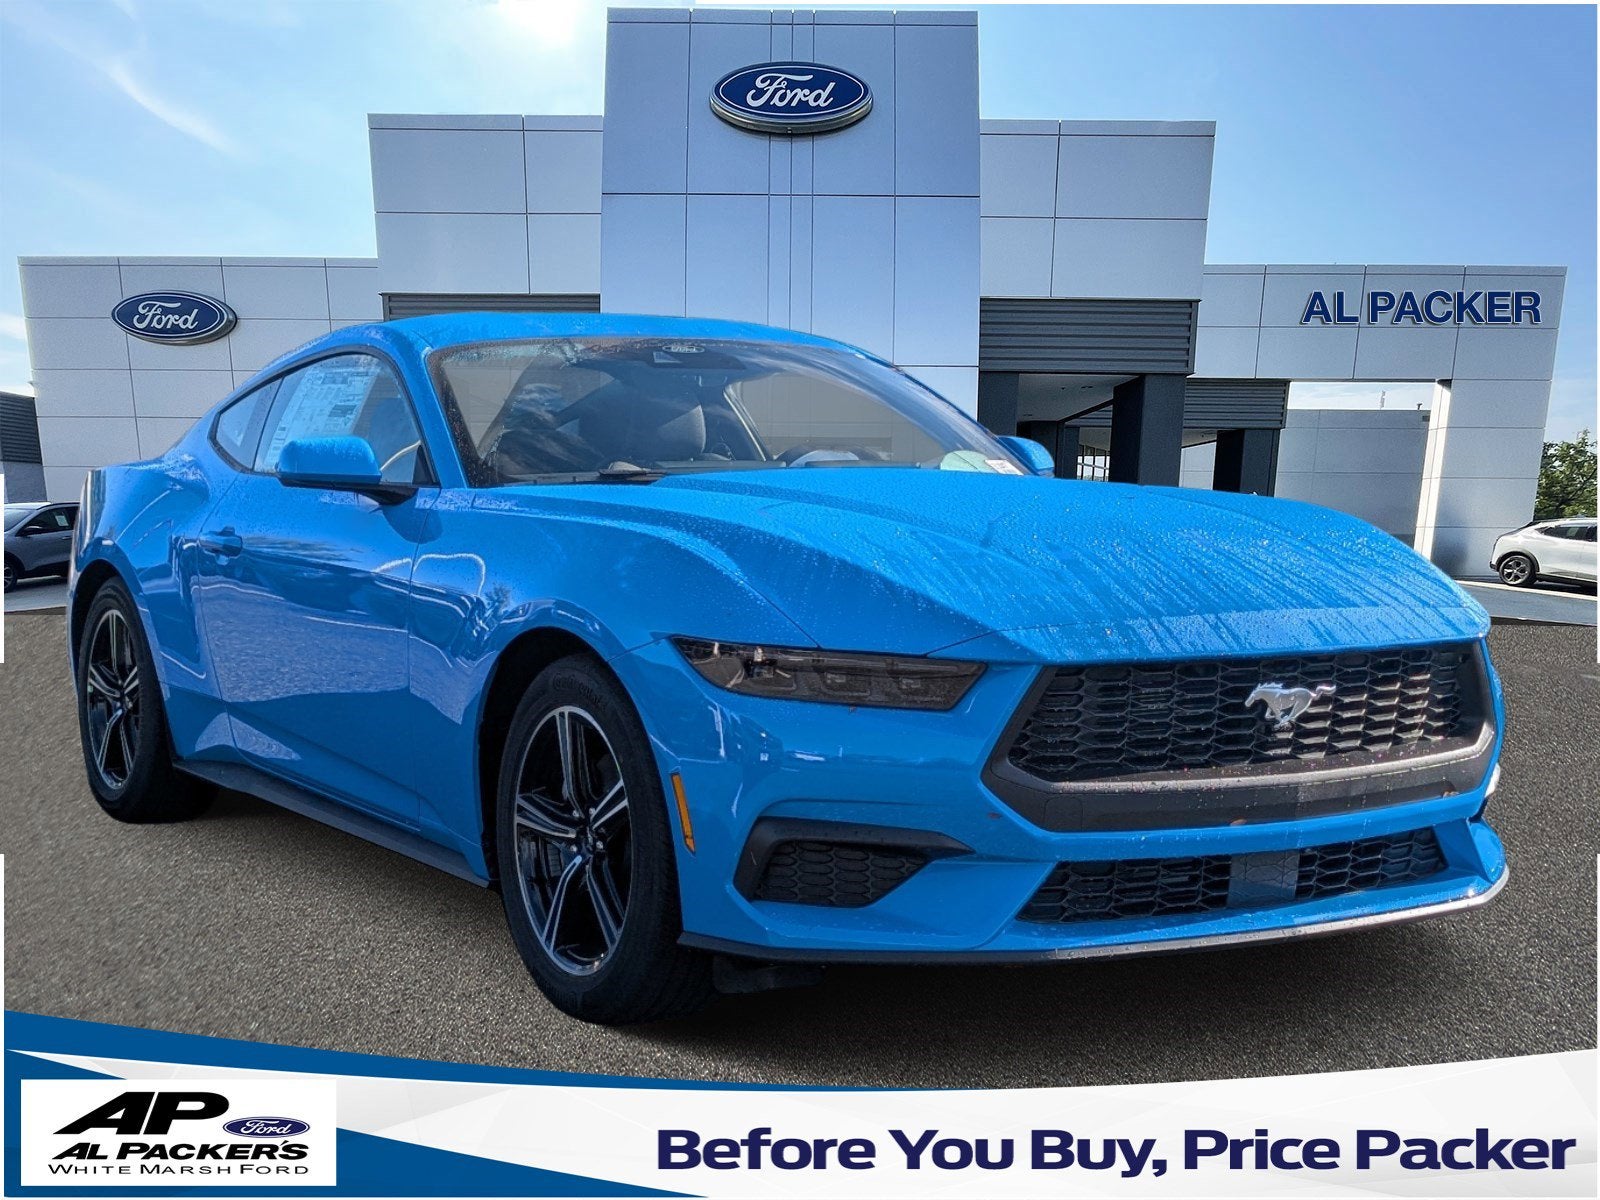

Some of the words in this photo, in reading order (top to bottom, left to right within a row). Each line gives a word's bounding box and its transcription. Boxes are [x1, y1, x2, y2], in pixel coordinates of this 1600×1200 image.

[746, 73, 836, 107] Ford
[133, 301, 199, 329] Ford
[1302, 291, 1359, 324] AL
[1369, 290, 1542, 324] PACKER
